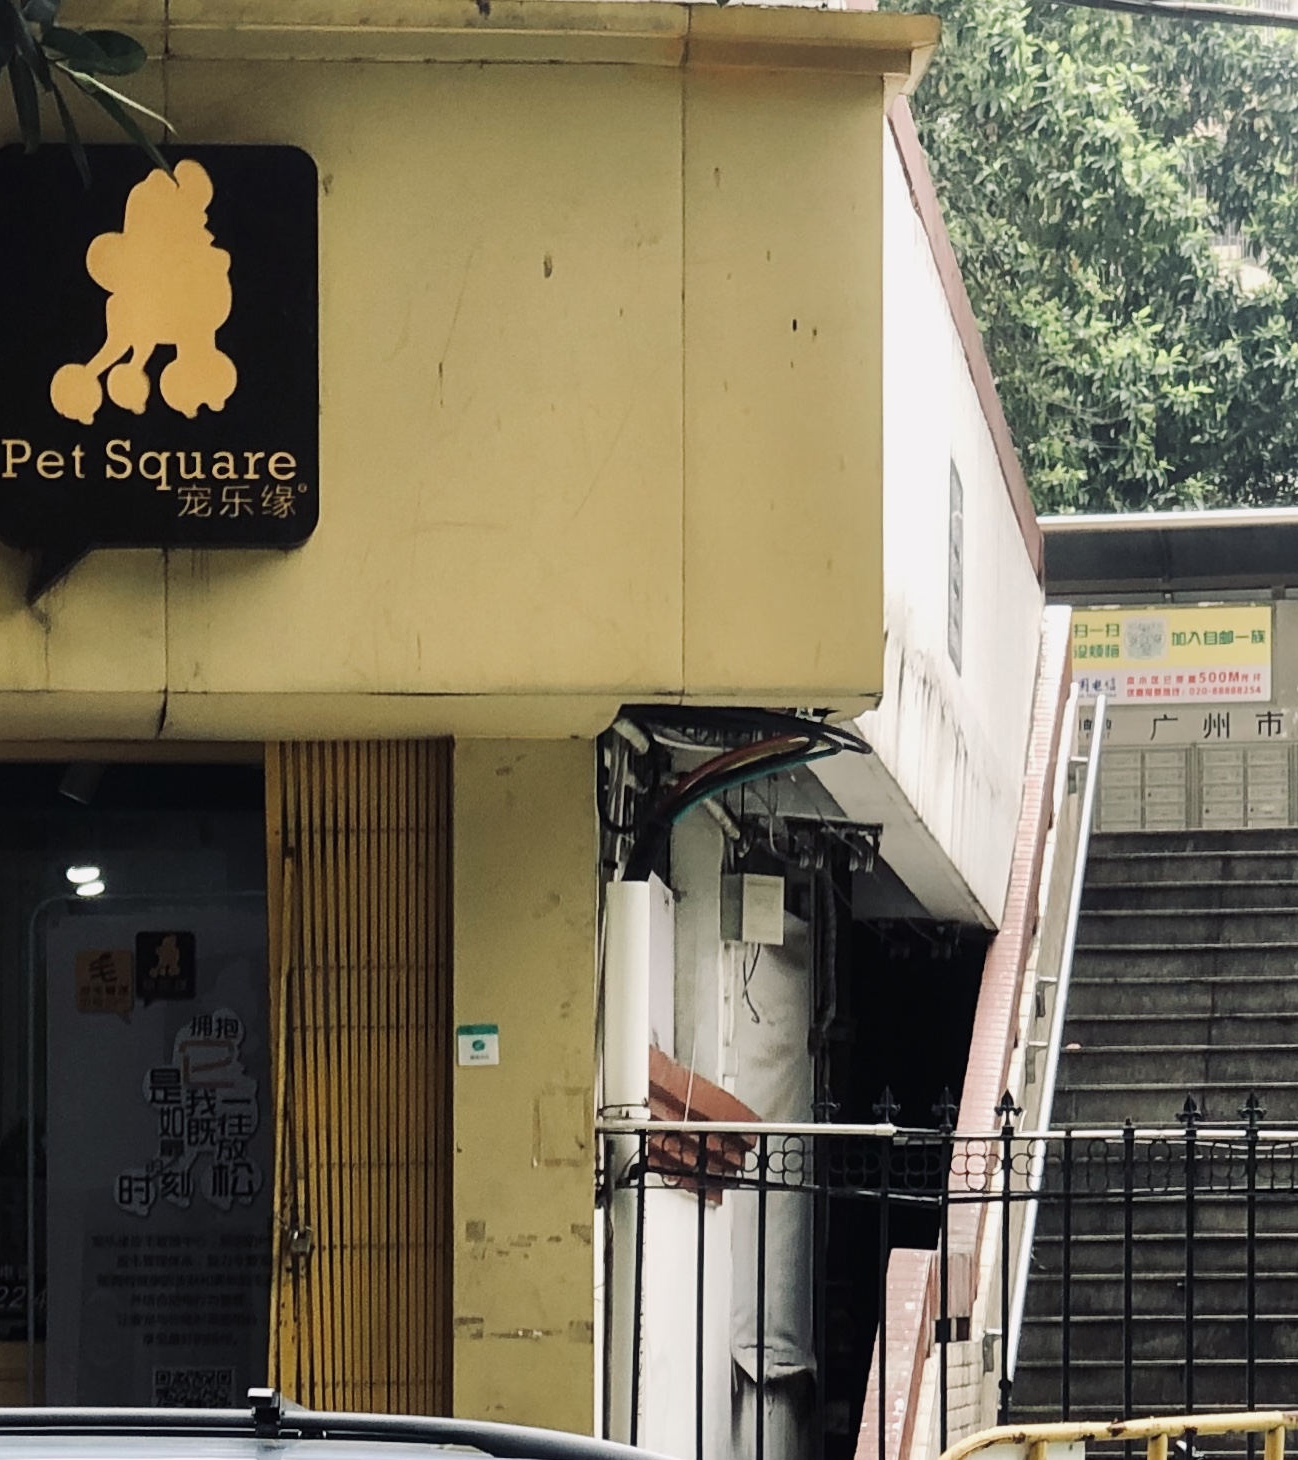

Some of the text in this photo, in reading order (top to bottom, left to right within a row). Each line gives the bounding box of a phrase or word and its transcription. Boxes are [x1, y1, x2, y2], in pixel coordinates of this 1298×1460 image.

[1, 439, 298, 491] Pet Square
[177, 483, 297, 520] 宠乐缘
[1073, 622, 1121, 639] 扫一扫
[1171, 629, 1267, 647] 加入自邮一族
[189, 1014, 240, 1039] 拥抱
